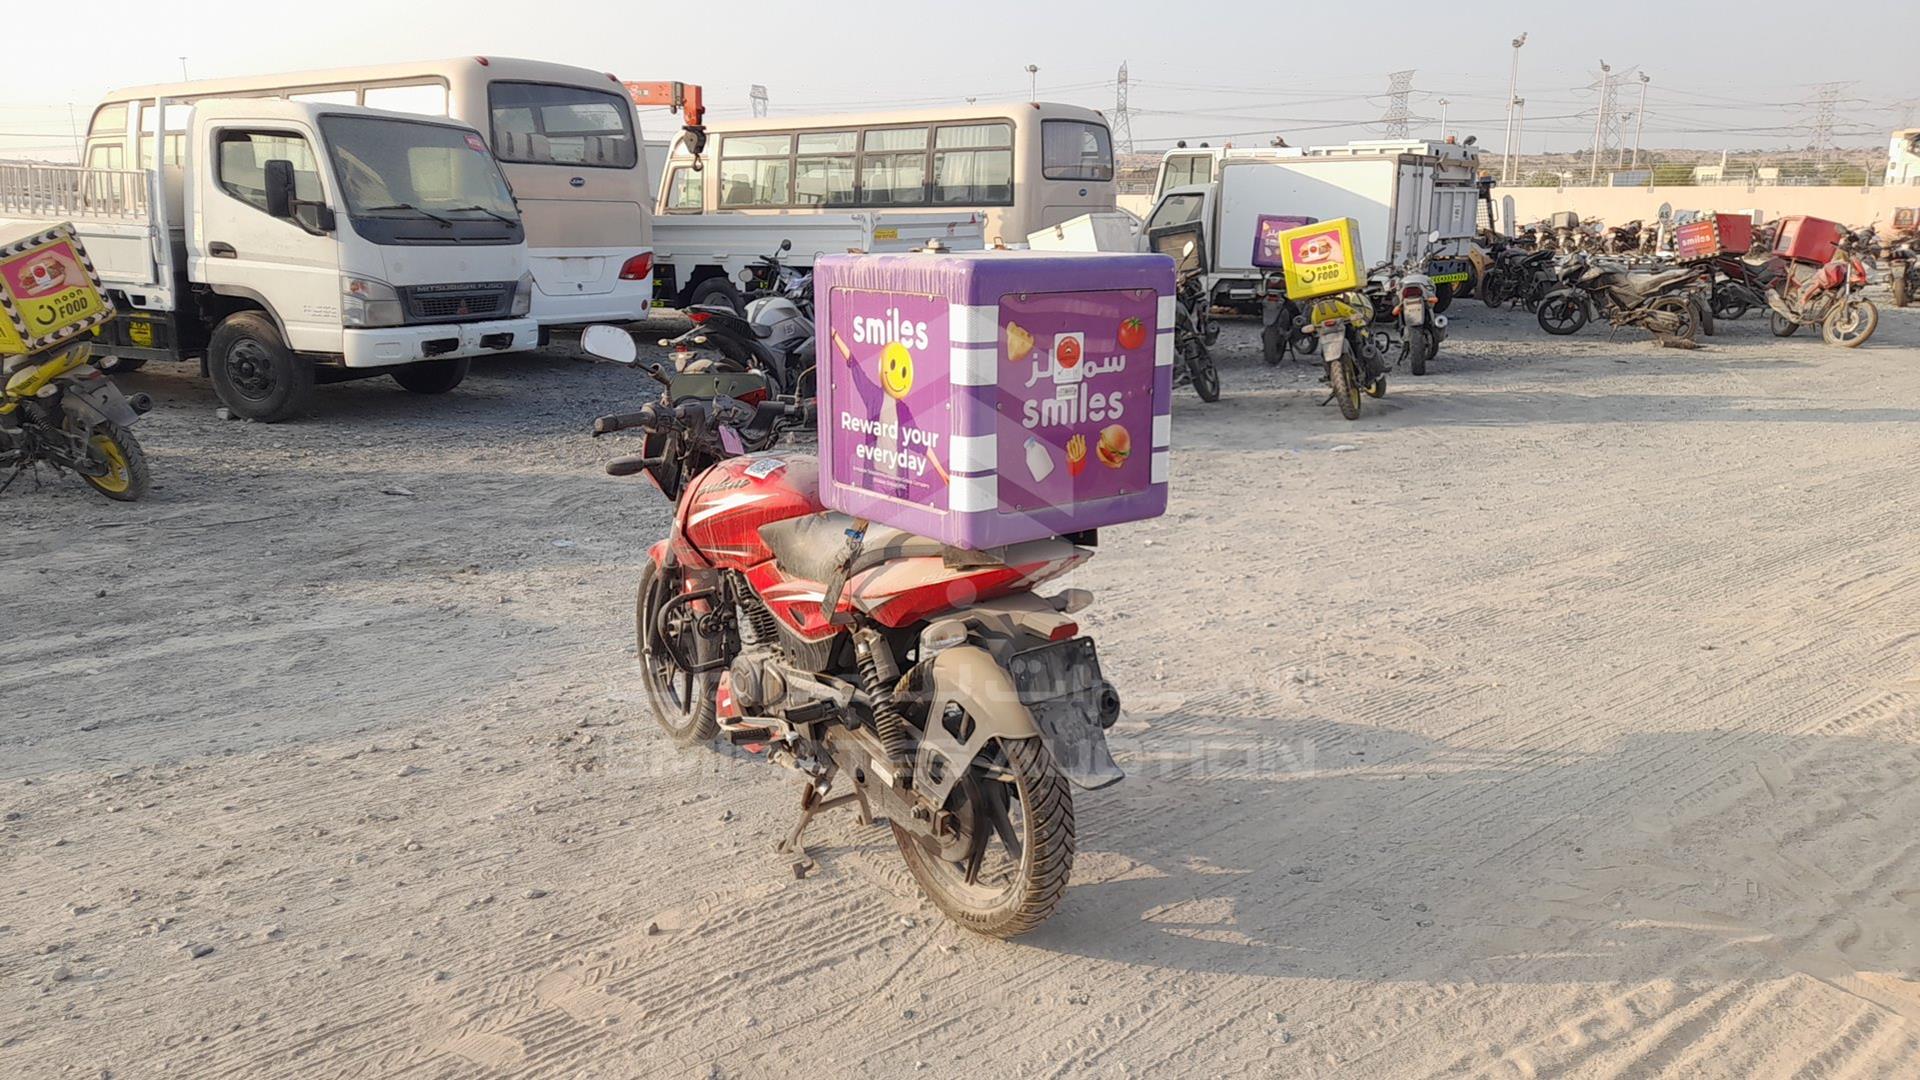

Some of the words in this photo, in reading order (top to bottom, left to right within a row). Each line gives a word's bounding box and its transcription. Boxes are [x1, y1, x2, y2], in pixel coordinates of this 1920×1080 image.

[1682, 234, 1710, 246] smiles
[1317, 263, 1338, 272] noon
[1318, 270, 1340, 281] FOOD
[417, 283, 476, 293] MITSUBISHI
[479, 282, 504, 291] FUSO
[54, 289, 83, 305] noon
[59, 297, 88, 318] FOOD
[853, 307, 928, 350] smiles
[1022, 382, 1124, 429] smiles
[841, 411, 898, 440] Reward
[902, 426, 939, 448] your
[856, 443, 926, 477] everyday
